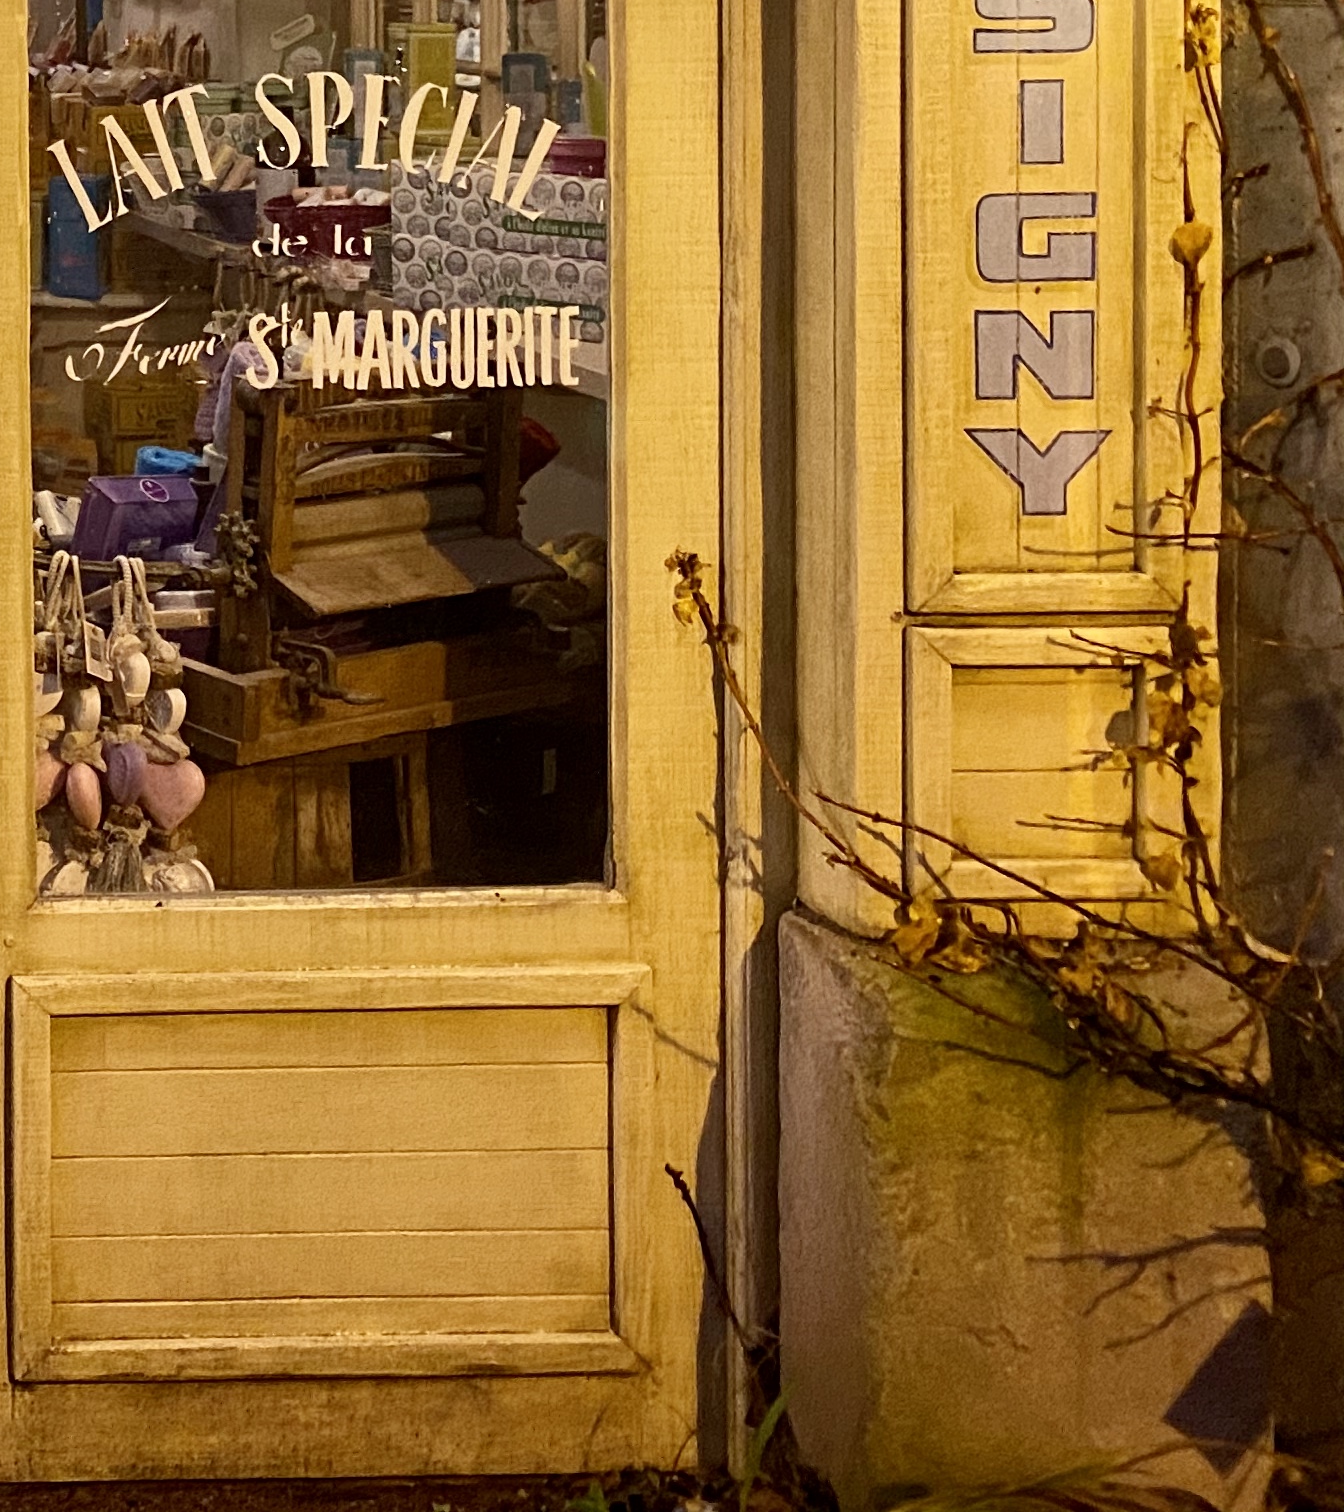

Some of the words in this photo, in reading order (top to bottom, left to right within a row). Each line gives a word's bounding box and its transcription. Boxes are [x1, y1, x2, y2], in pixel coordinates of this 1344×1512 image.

[46, 84, 218, 234] LAIT
[251, 223, 308, 258] de
[334, 223, 372, 258] la
[312, 304, 581, 392] MARGUERITE
